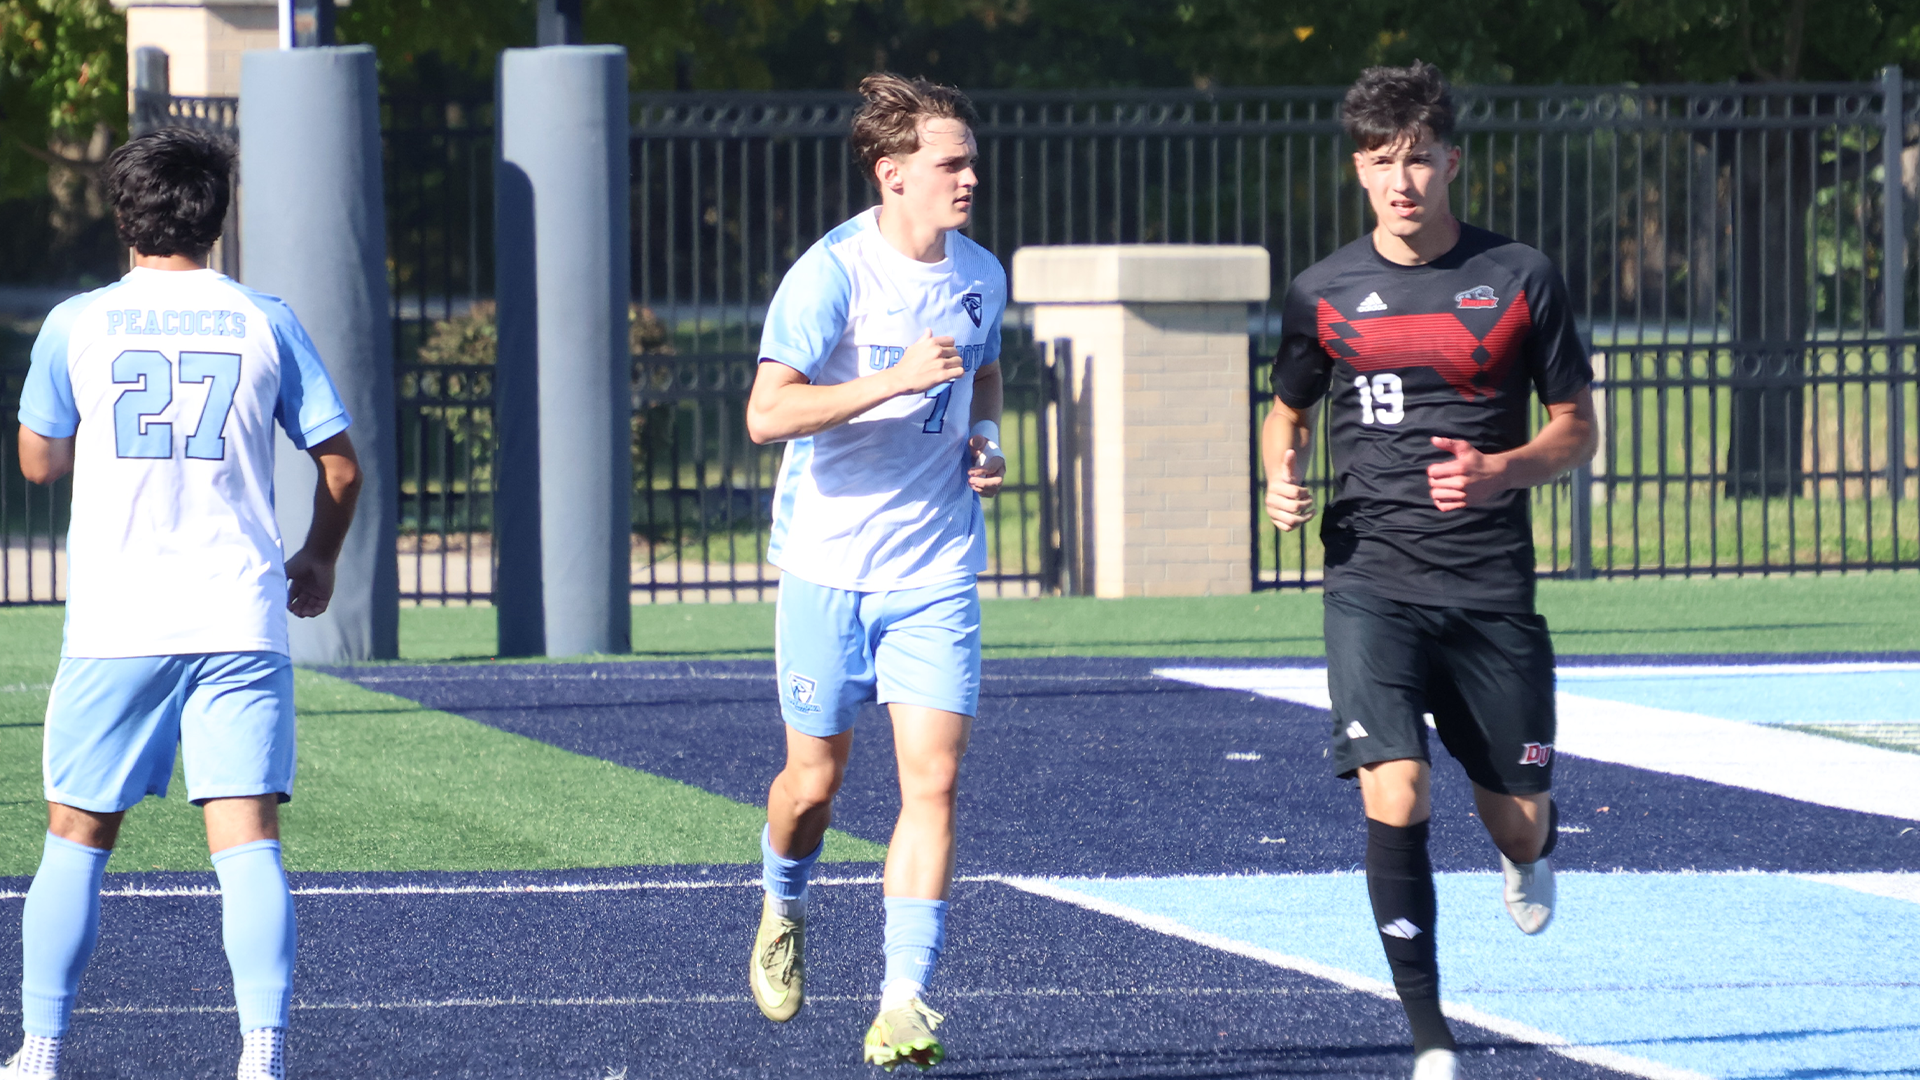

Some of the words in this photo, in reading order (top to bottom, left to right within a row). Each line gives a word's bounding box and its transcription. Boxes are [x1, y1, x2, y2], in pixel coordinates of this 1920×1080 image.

[106, 309, 246, 338] PEACOCKS
[111, 350, 242, 461] 27
[922, 381, 954, 434] 7
[1353, 373, 1405, 425] 19
[1518, 742, 1553, 767] DU
